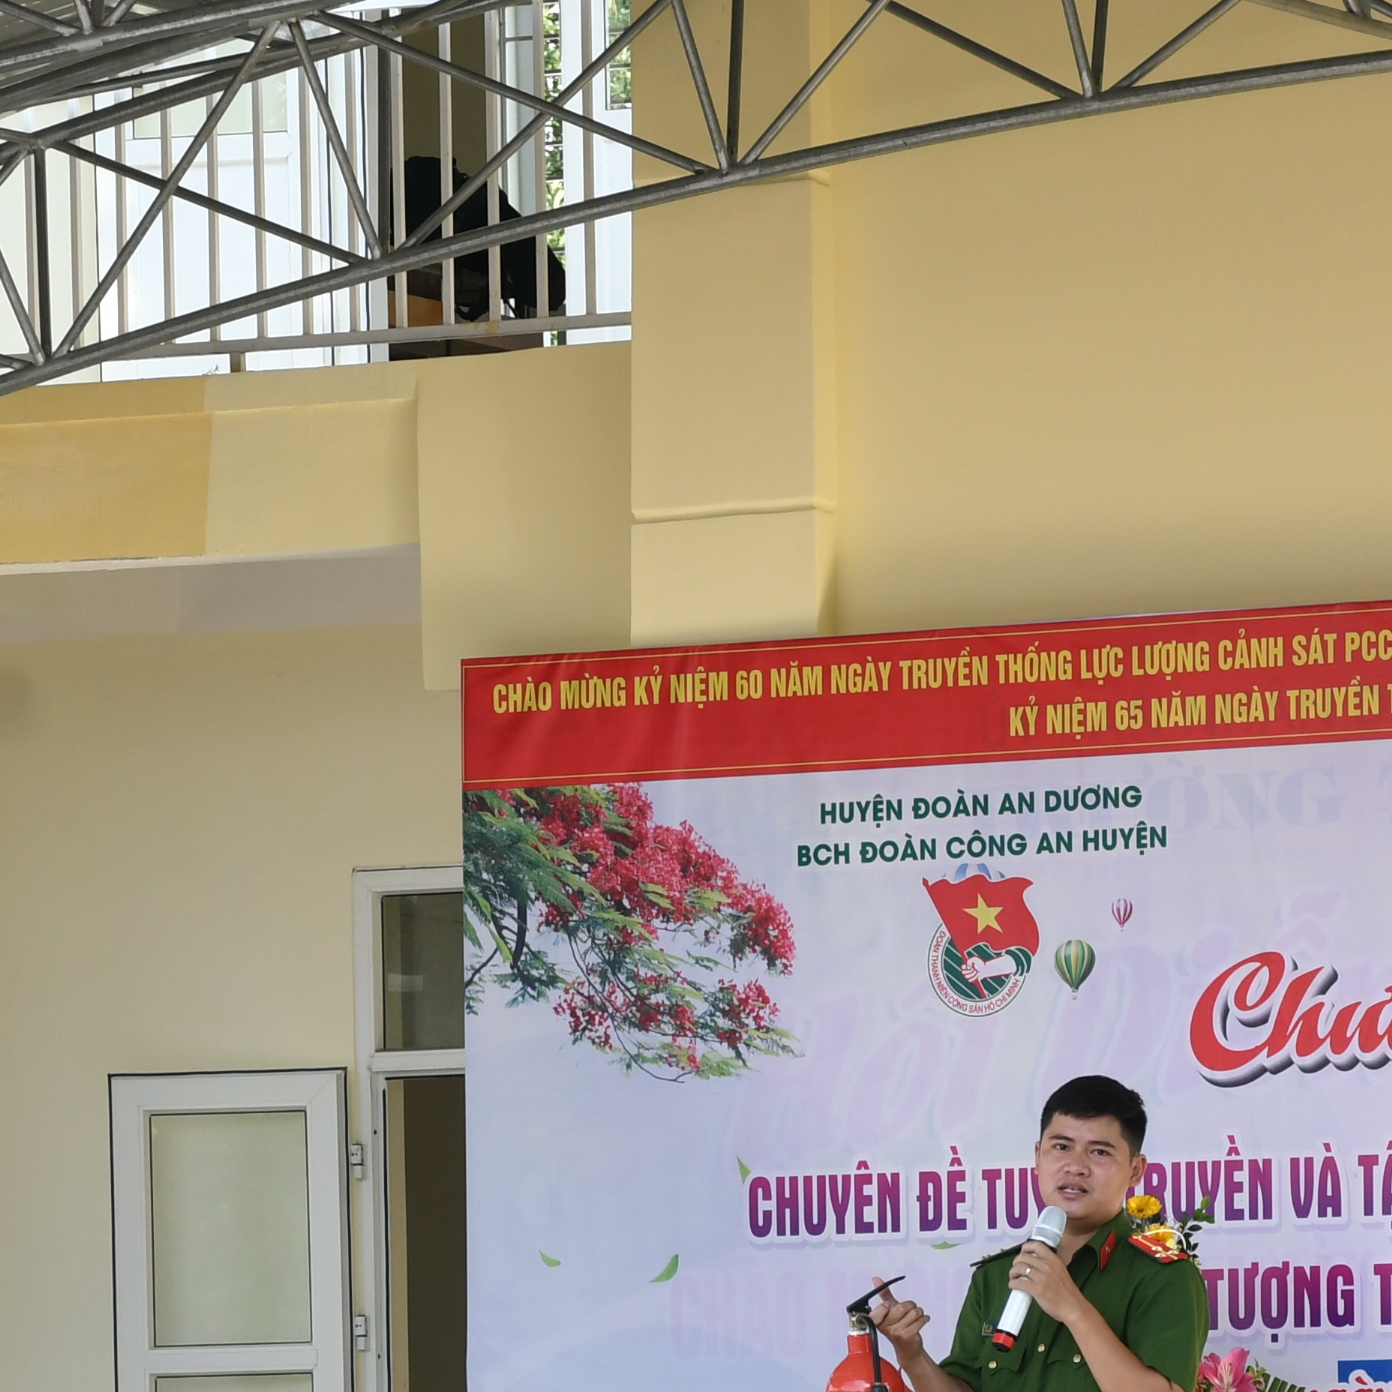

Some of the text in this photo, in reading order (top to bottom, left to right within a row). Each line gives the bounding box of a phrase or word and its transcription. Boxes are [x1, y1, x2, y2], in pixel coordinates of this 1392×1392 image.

[493, 676, 552, 714] CHÀO
[560, 673, 627, 710] MỪNG
[634, 665, 663, 706] KỶ
[670, 666, 729, 709] NIỆM
[735, 669, 763, 700] 60
[770, 661, 823, 698] NĂM
[830, 656, 892, 694] NGÀY
[899, 646, 989, 690] TRUYỀN
[995, 646, 1073, 684] THỐNG
[1080, 644, 1124, 685] LỰC
[1132, 640, 1210, 681] LƯỢNG
[1218, 628, 1284, 671] CẢNH
[1292, 627, 1338, 666] SÁT
[1009, 695, 1039, 737] KỶ
[1046, 696, 1108, 740] NIỆM
[1115, 699, 1144, 731] 65
[1151, 690, 1207, 729] NĂM
[1214, 685, 1279, 725] NGÀY
[1286, 675, 1380, 720] TRUYỀN
[821, 785, 1142, 828] HUYỆN ĐOÀN AN DƯƠNG
[798, 821, 1168, 867] BCH ĐOÀN CÔNG AN HUYỆN
[931, 954, 940, 982] THANH
[1005, 978, 1021, 998] MINH
[750, 1161, 899, 1236] CHUYÊN
[916, 1147, 966, 1231] ĐỀ
[1291, 1144, 1341, 1217] VÀ
